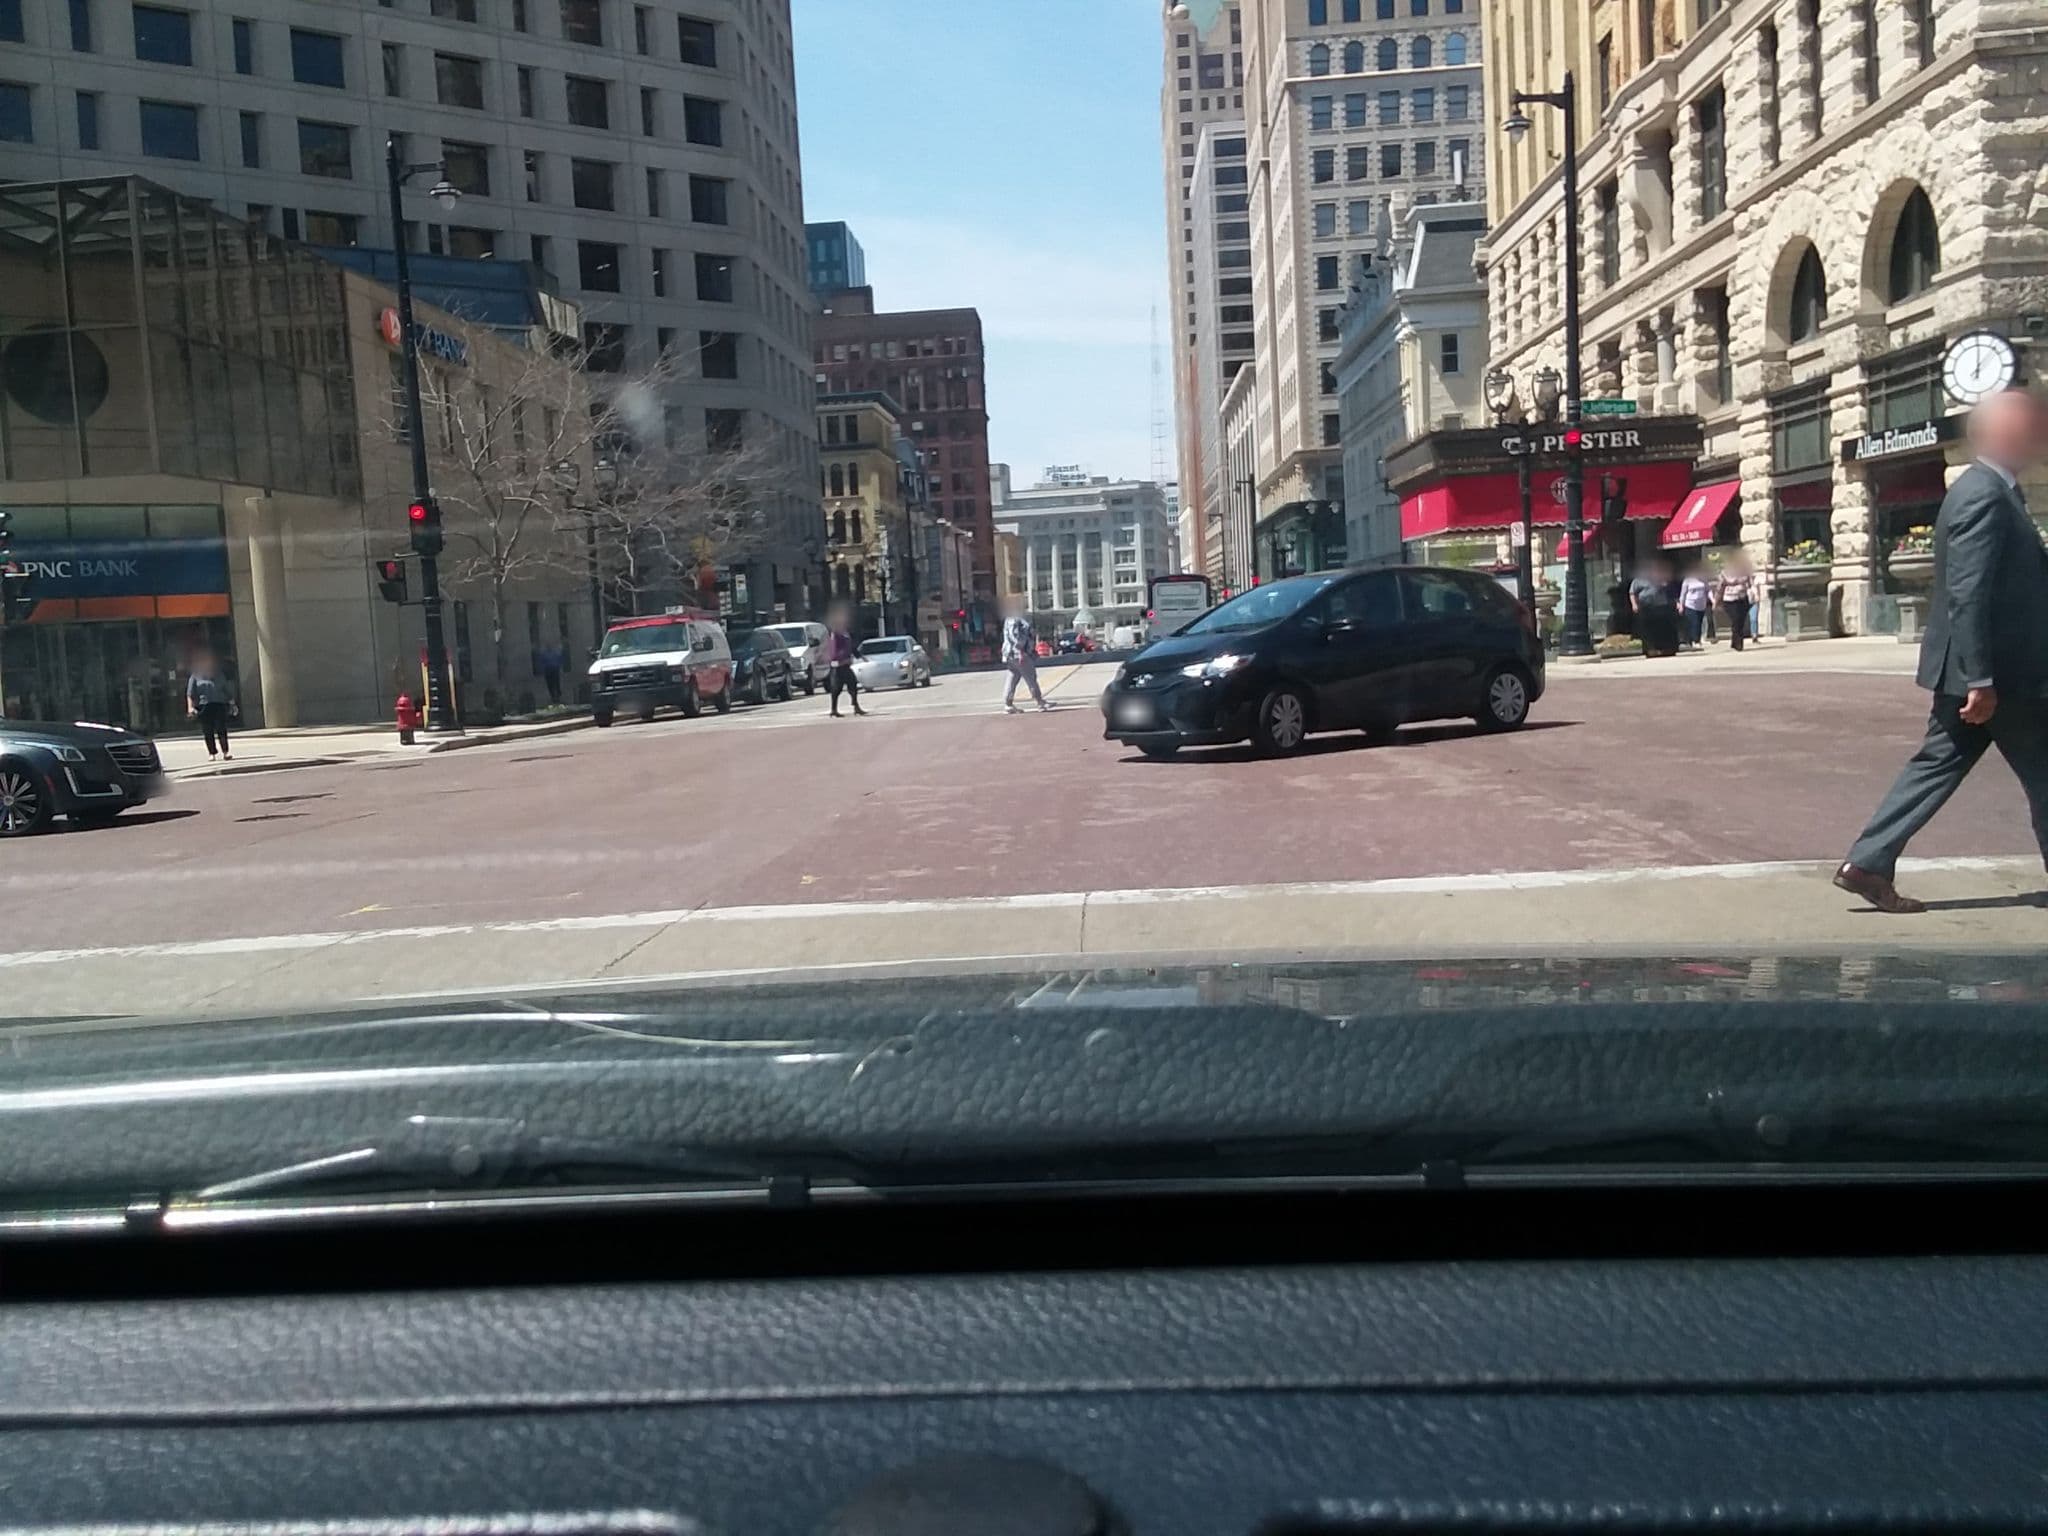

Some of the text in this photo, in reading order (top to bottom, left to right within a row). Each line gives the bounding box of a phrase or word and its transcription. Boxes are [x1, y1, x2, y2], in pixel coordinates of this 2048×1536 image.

[1543, 430, 1641, 452] PFSTER
[1855, 421, 1938, 460] Allen Edmonds
[21, 560, 139, 578] PNC BANK
